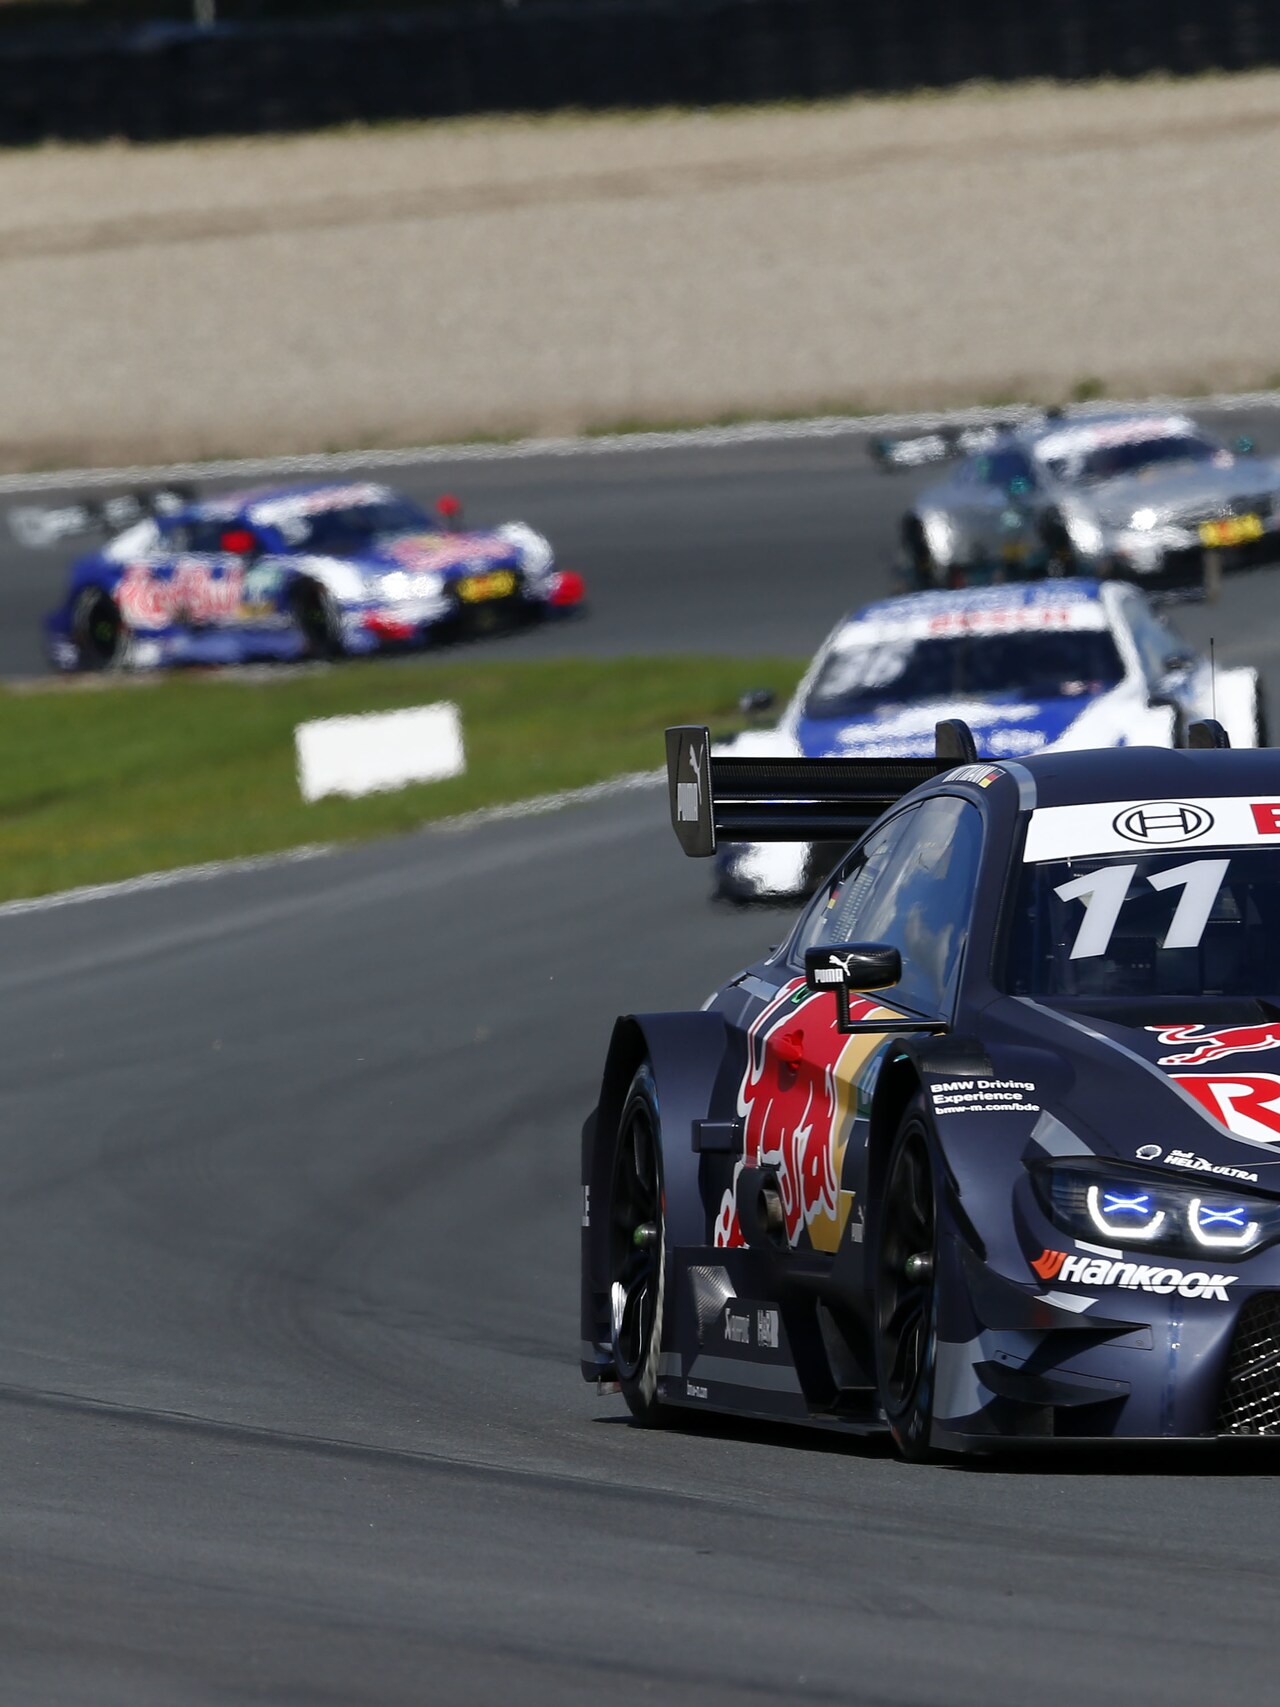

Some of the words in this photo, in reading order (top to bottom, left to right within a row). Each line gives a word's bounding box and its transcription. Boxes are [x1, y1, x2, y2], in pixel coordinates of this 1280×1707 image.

[1053, 859, 1231, 960] 11
[930, 1081, 974, 1093] BMW
[977, 1079, 1036, 1092] Driving
[932, 1091, 1023, 1105] Experience
[935, 1103, 1040, 1115] bmw-m.com/bde
[1212, 1165, 1259, 1182] ULTRA
